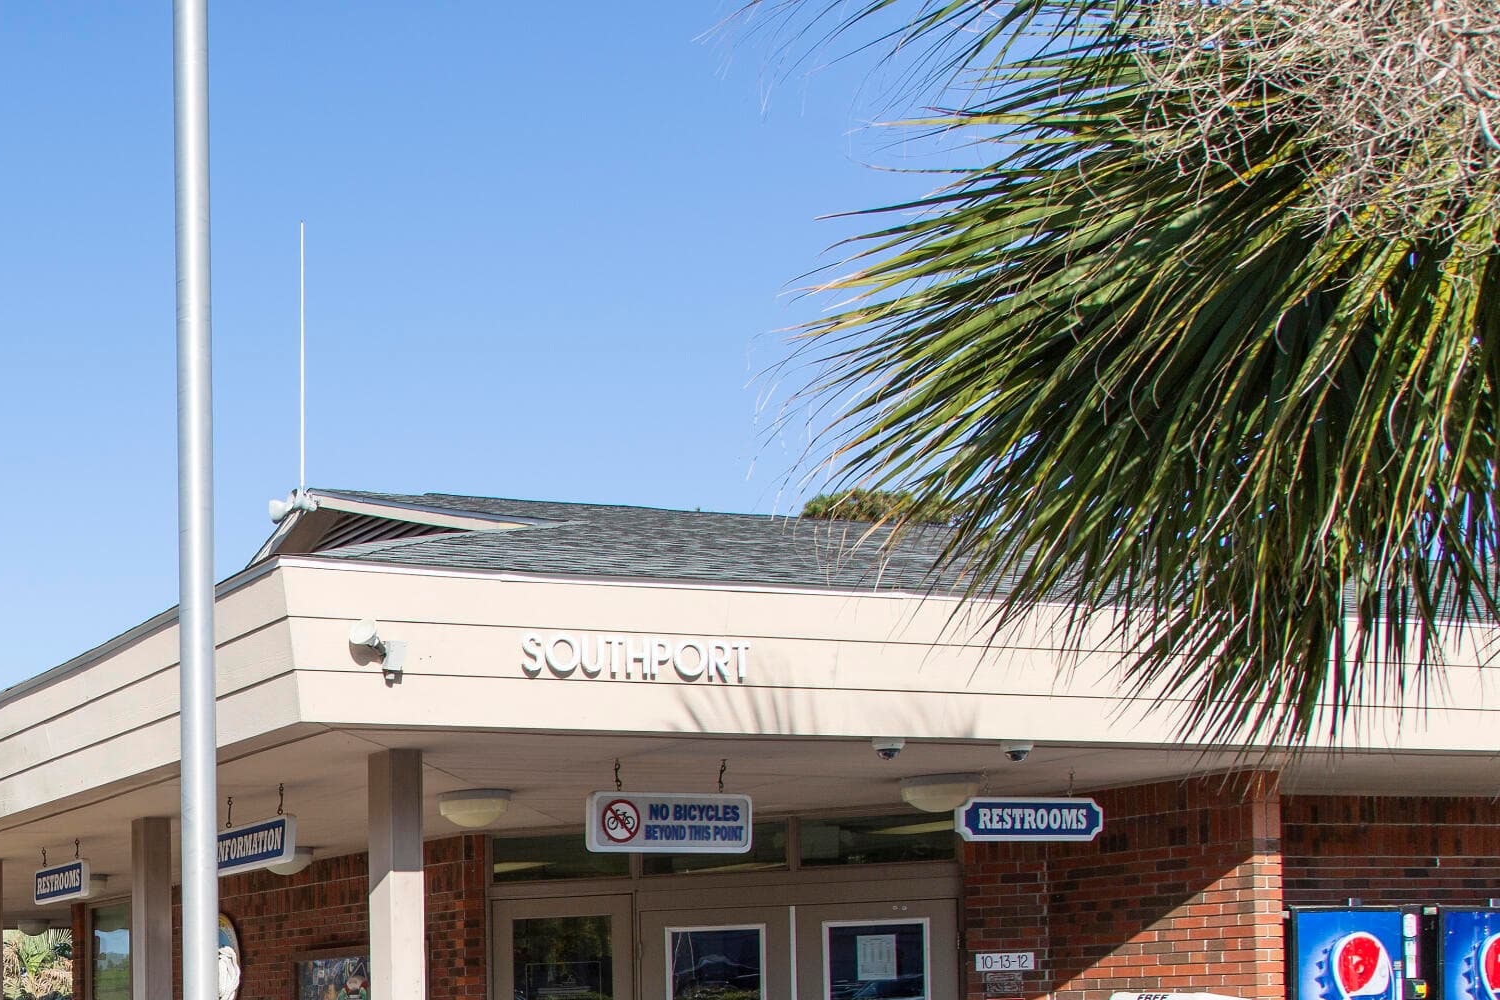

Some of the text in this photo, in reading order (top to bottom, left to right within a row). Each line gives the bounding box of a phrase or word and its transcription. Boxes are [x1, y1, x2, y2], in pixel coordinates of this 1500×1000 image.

[521, 632, 751, 681] SOUTHPORT
[649, 804, 740, 822] NO BICYCLES
[978, 808, 1087, 830] RESTROOMS
[644, 824, 744, 841] BEYOND THIS POINT
[36, 869, 81, 895] RESTROOMS
[981, 954, 1029, 969] 10-13-12
